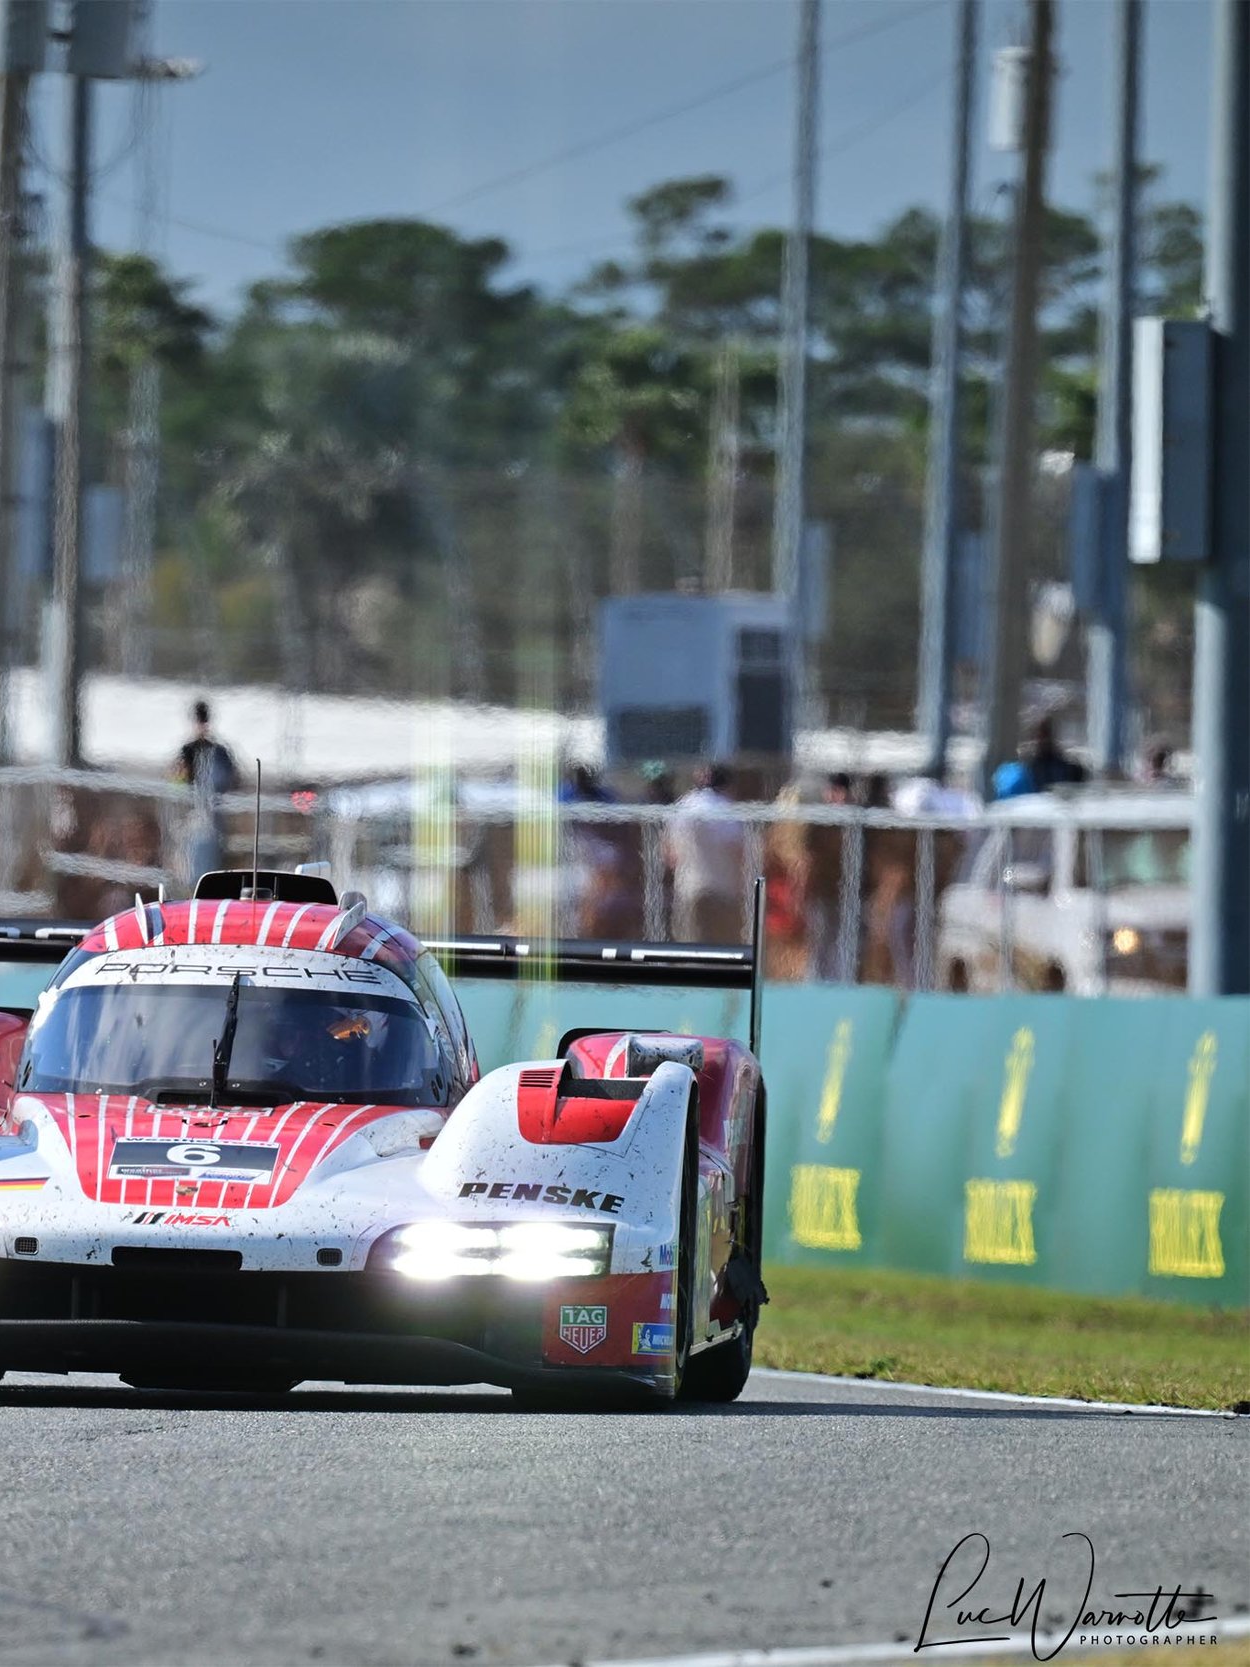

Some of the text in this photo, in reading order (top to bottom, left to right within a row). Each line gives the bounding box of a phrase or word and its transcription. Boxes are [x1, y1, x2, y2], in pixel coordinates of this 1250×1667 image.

[94, 962, 382, 984] PORSCHE
[166, 1144, 221, 1165] 6
[457, 1182, 625, 1214] PENSKE
[163, 1214, 231, 1226] IMSA
[564, 1309, 603, 1324] TAG
[563, 1327, 604, 1350] HEUER
